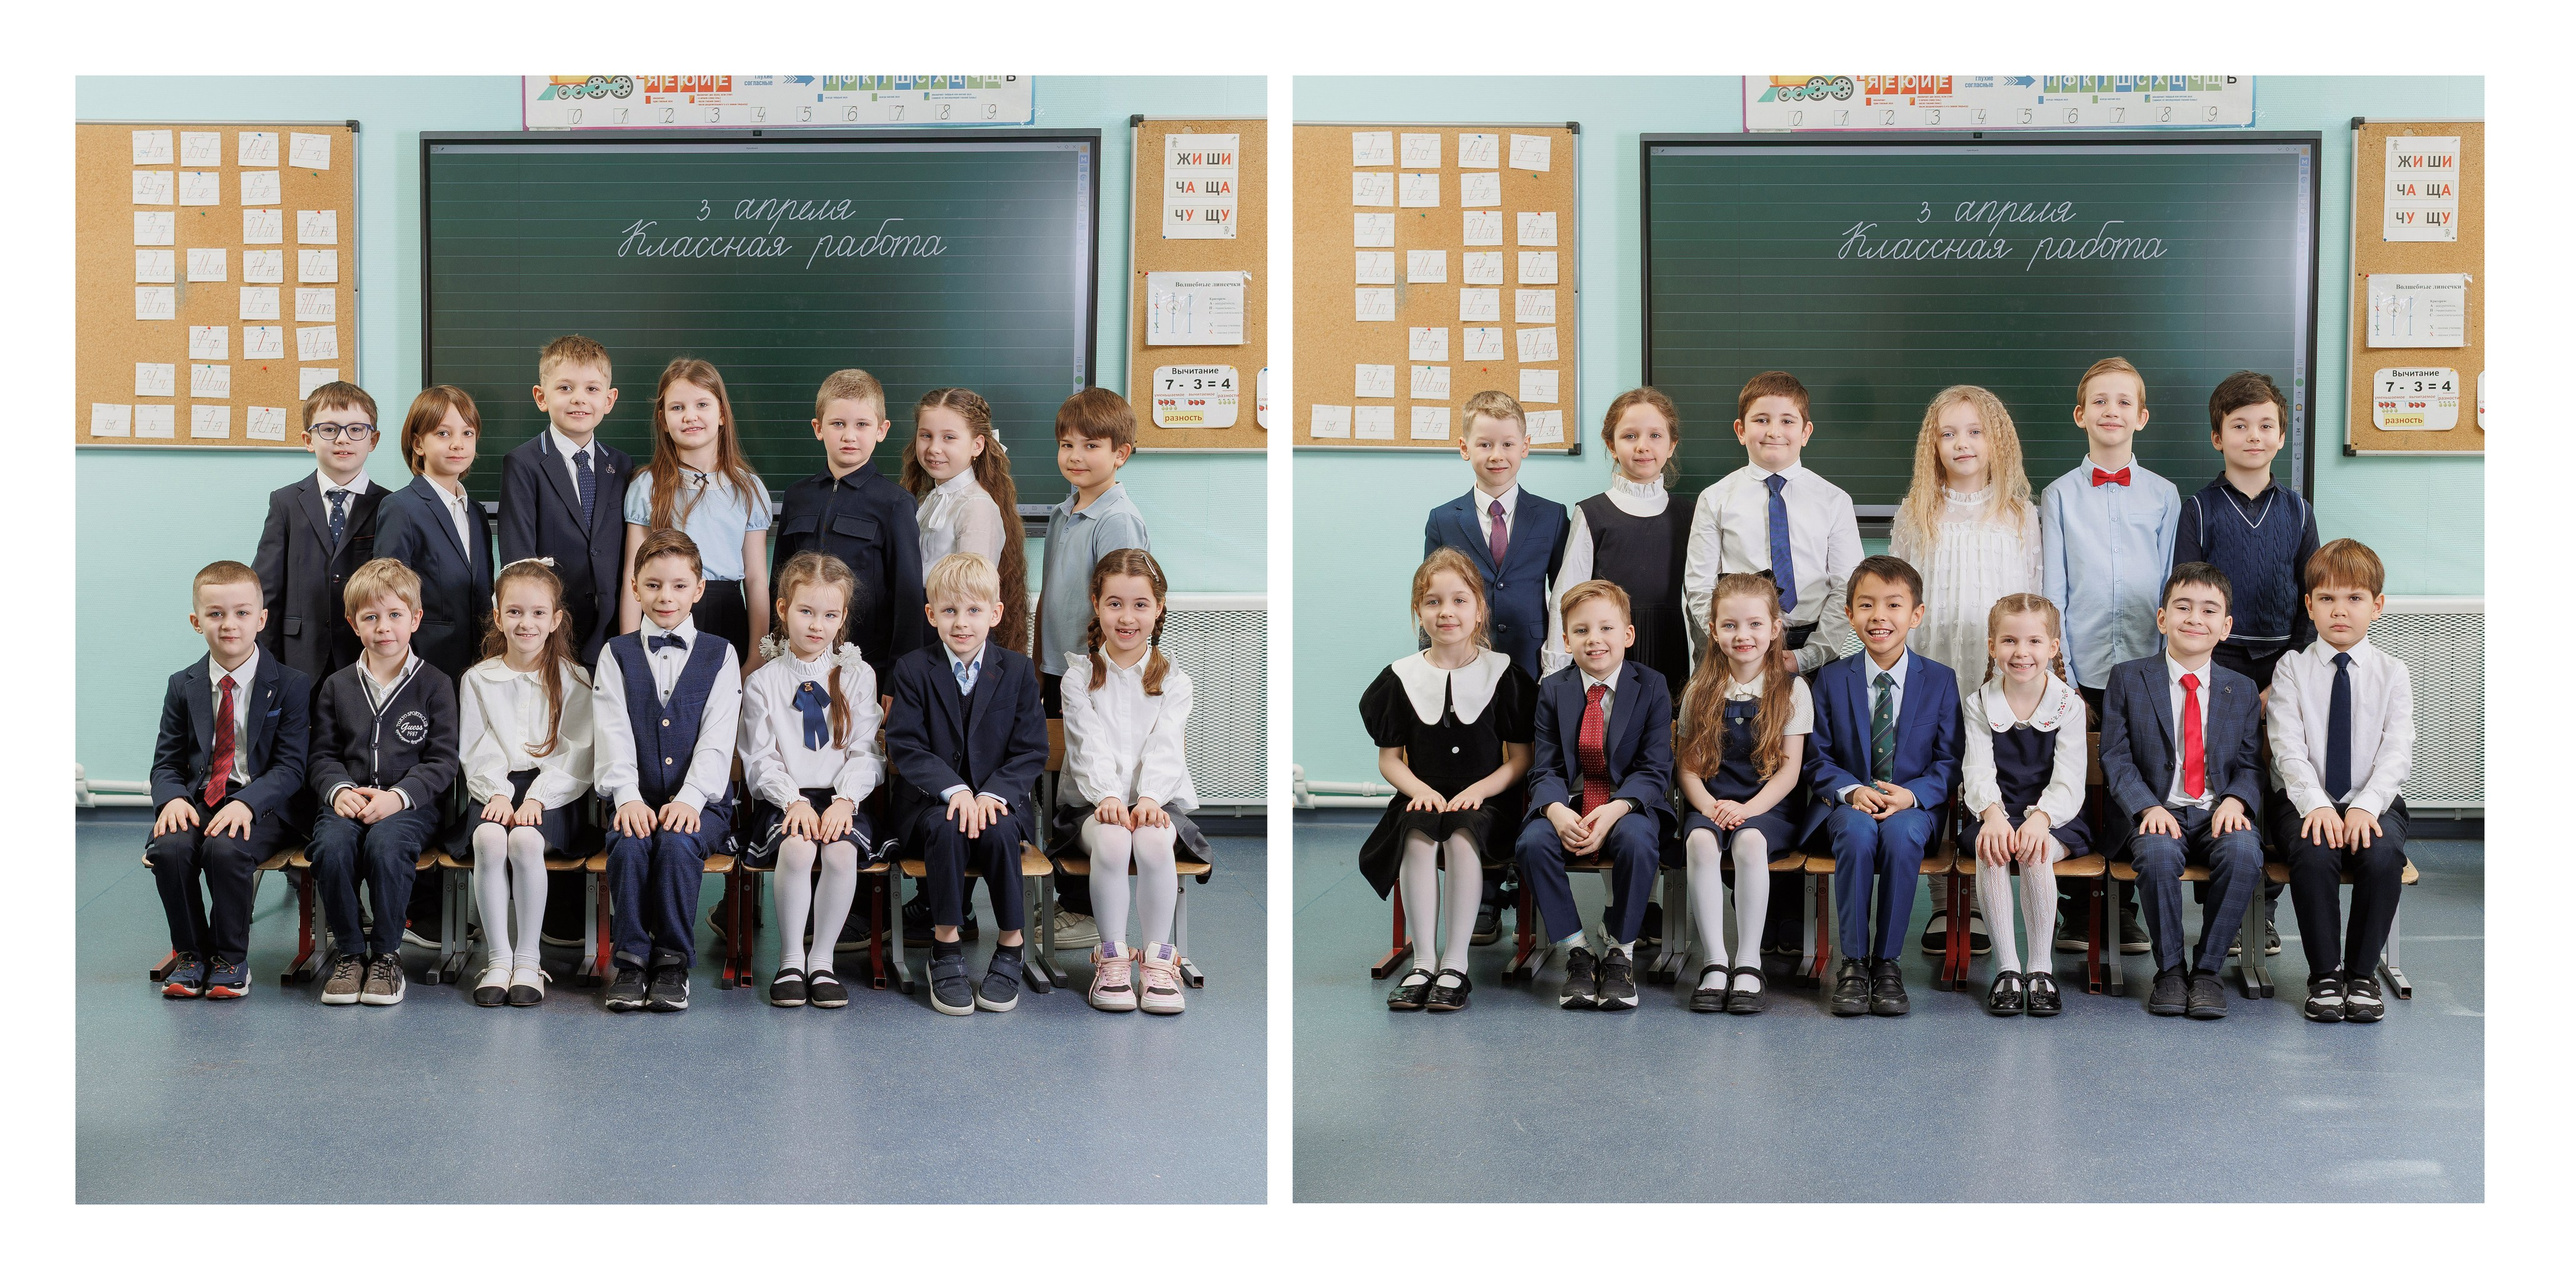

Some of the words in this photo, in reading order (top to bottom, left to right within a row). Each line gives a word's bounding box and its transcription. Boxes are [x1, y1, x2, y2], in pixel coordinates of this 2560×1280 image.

[1867, 76, 1878, 88] Я
[1902, 76, 1916, 88] Ю
[572, 109, 582, 124] 0
[621, 108, 628, 124] 1
[665, 108, 674, 124] 2
[710, 108, 720, 123] 3
[757, 107, 766, 123] 4
[802, 106, 812, 122] 5
[848, 106, 857, 122] 6
[895, 105, 904, 121] 7
[940, 104, 950, 120] 8
[987, 104, 996, 119] 9
[1793, 110, 1802, 126] 0
[1842, 110, 1849, 126] 1
[1886, 110, 1894, 125] 2
[1931, 110, 1940, 125] 3
[1978, 109, 1986, 125] 4
[2022, 108, 2032, 124] 5
[2068, 108, 2078, 124] 6
[2116, 107, 2125, 123] 7
[2162, 107, 2171, 122] 8
[2208, 106, 2217, 122] 9
[185, 137, 218, 158] Бб
[244, 138, 271, 159] Вв
[1406, 138, 1438, 160] Бб
[1464, 140, 1491, 161] Вв
[1177, 153, 1202, 165] ЖИ
[1207, 153, 1231, 165] ШИ
[2398, 156, 2422, 167] ЖИ
[2428, 156, 2451, 167] ШИ
[138, 176, 166, 202] Дд
[1176, 182, 1195, 193] ЧА
[1206, 182, 1230, 195] ЩА
[1358, 178, 1386, 204] Дд
[2397, 184, 2416, 196] ЧА
[2427, 184, 2451, 198] ЩА
[248, 216, 276, 237] Йй
[697, 200, 710, 221] 3
[734, 198, 856, 234] апреля
[1175, 210, 1194, 221] ЧУ
[1206, 210, 1230, 223] ЩУ
[1917, 202, 1931, 223] 3
[1954, 200, 2076, 236] апреля
[2396, 212, 2415, 224] ЧУ
[2427, 212, 2450, 226] ЩУ
[302, 218, 331, 237] Кк
[1468, 218, 1497, 239] Йй
[1522, 218, 1551, 239] Кк
[618, 219, 792, 258] Классная
[806, 218, 947, 270] работа
[1838, 221, 2013, 260] Классная
[2027, 221, 2167, 272] работа
[188, 254, 225, 275] Мм
[249, 256, 278, 276] Нн
[306, 255, 328, 276] Оо
[1408, 256, 1445, 276] Мм
[1469, 258, 1498, 278] Нн
[1526, 257, 1548, 278] Оо
[139, 292, 167, 313] Пп
[248, 292, 271, 313] Сс
[296, 292, 333, 314] Тт
[1359, 293, 1388, 314] Пп
[1468, 294, 1490, 314] Сс
[1516, 295, 1553, 316] Тт
[193, 330, 220, 356] Фф
[304, 332, 334, 358] Цц
[1413, 332, 1440, 357] Фф
[1524, 334, 1554, 359] Цц
[192, 370, 228, 390] Шш
[1165, 379, 1174, 390] 7
[1194, 379, 1202, 389] 3
[1222, 379, 1230, 389] 4
[1413, 371, 1448, 392] Шш
[2386, 382, 2394, 392] 7
[2414, 381, 2423, 392] 3
[2442, 381, 2451, 391] 4
[251, 412, 283, 433] Юю
[400, 722, 423, 733] Guess
